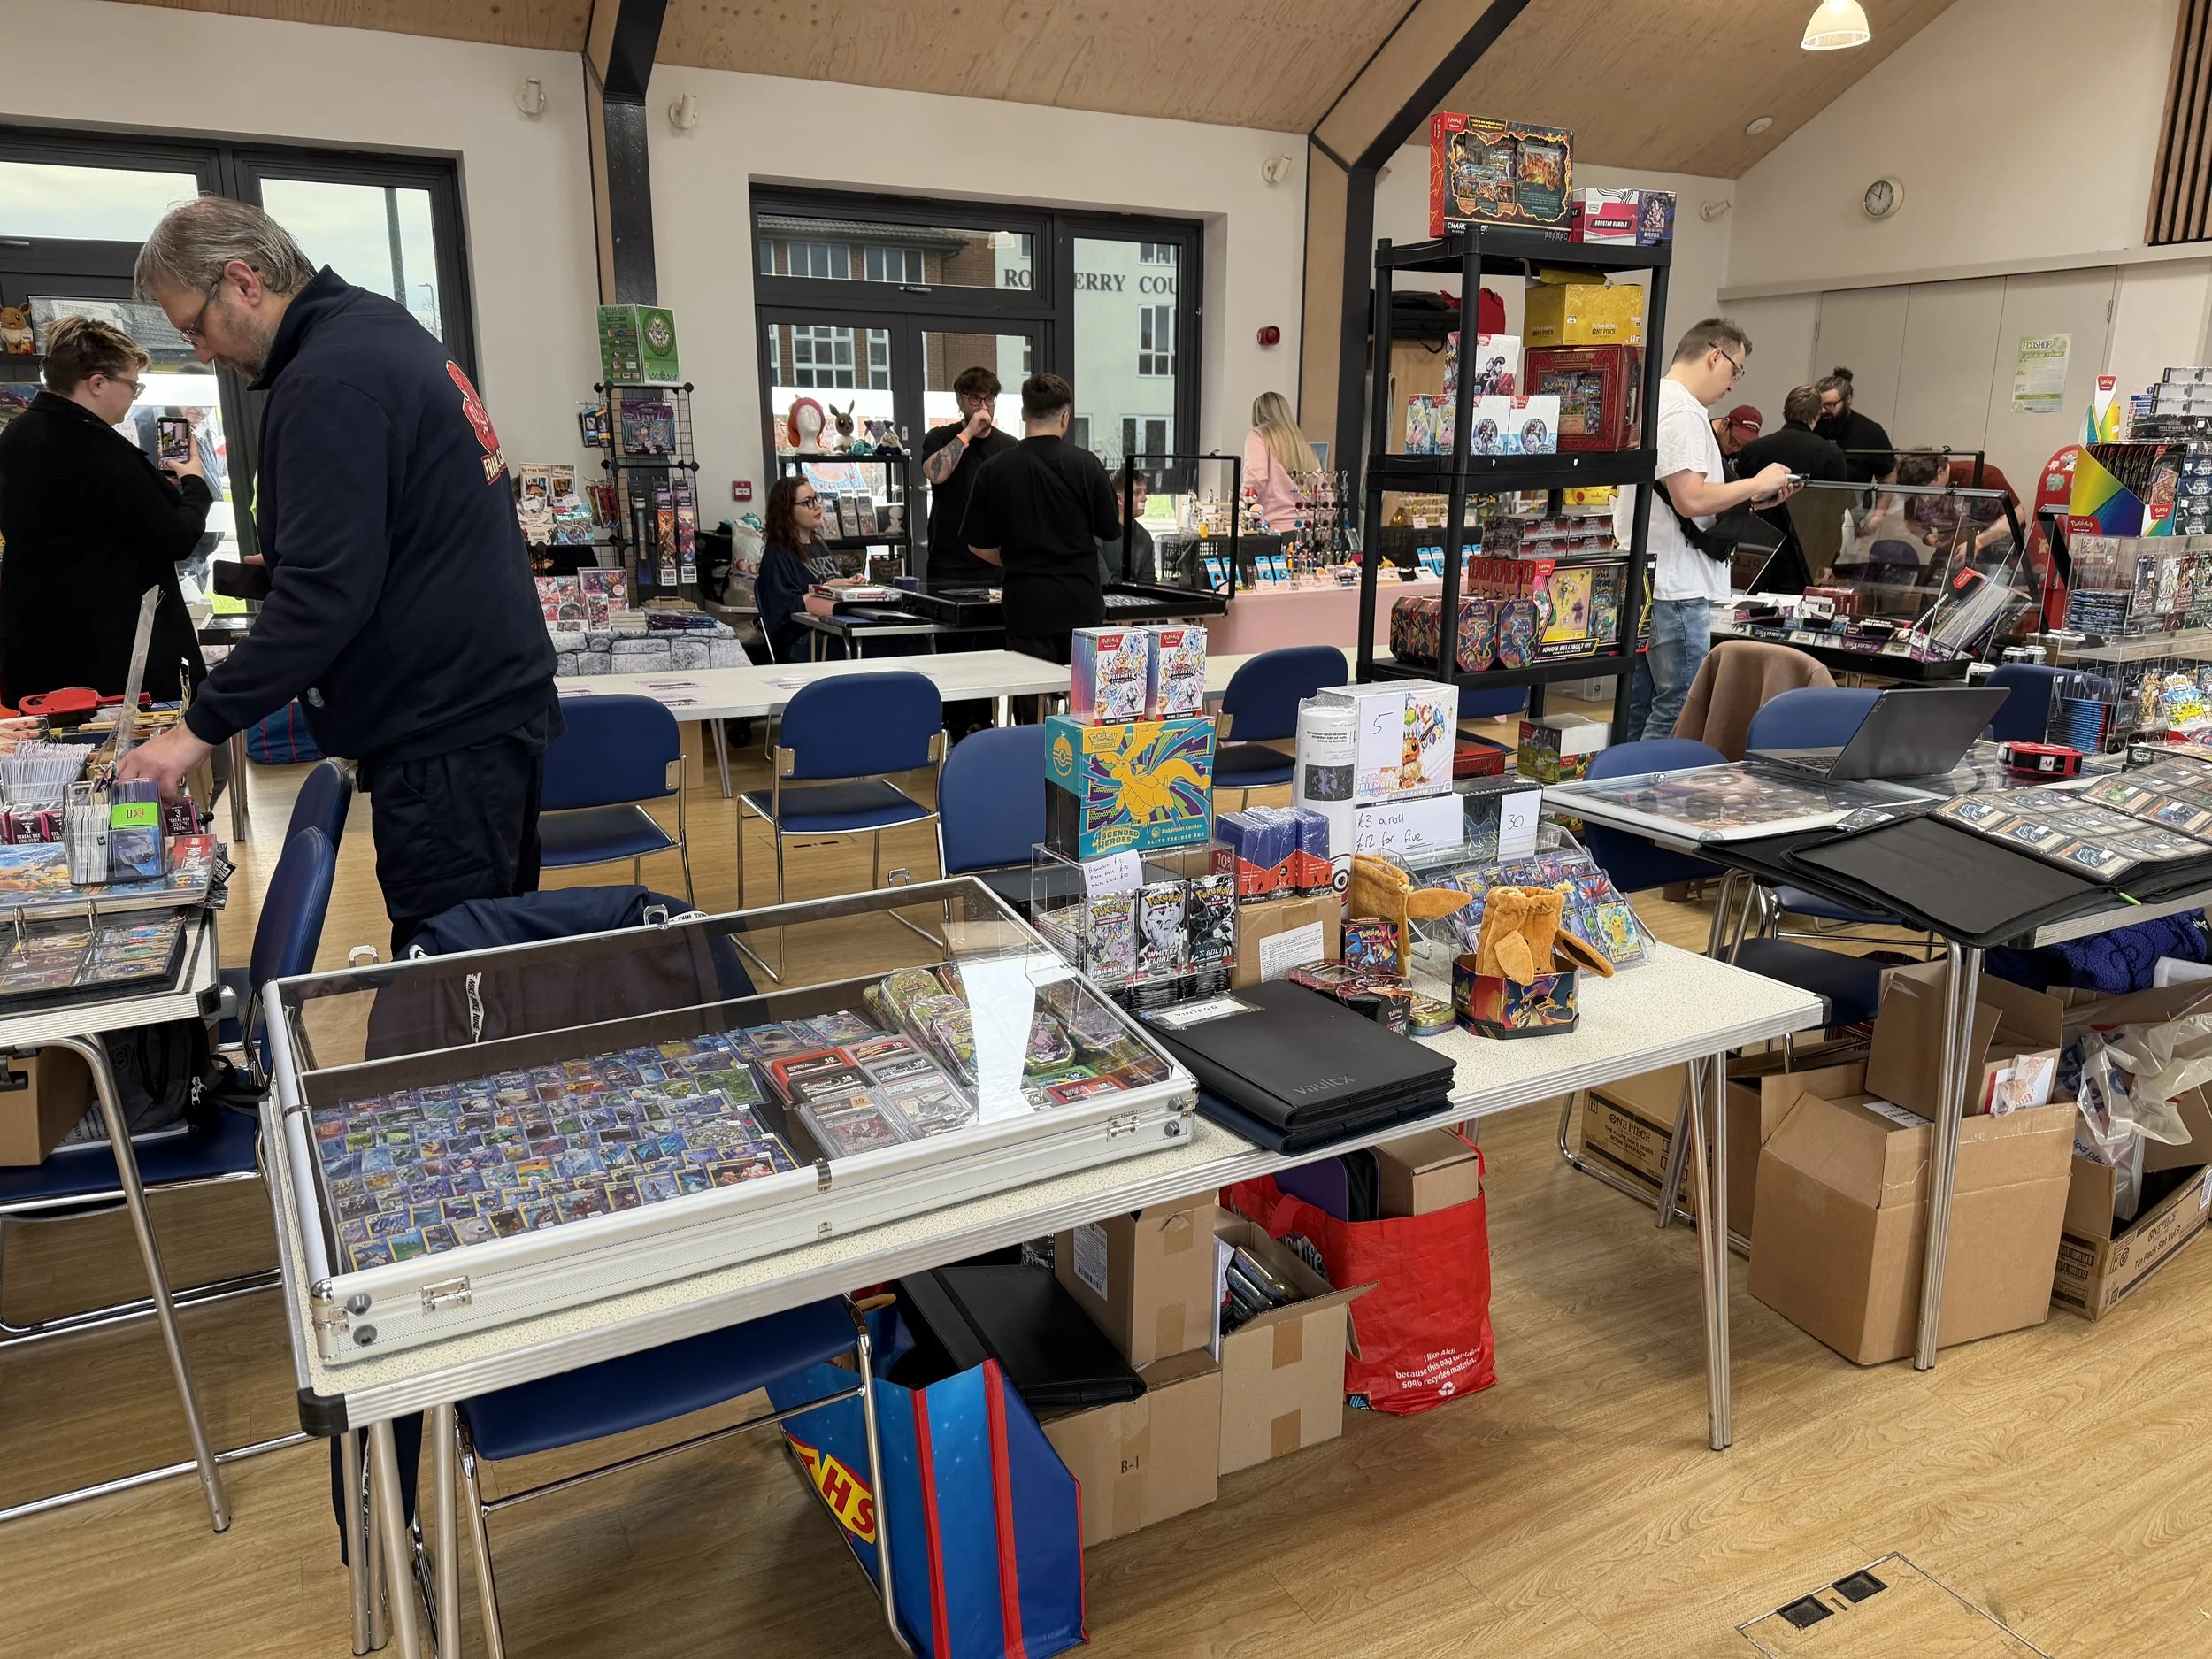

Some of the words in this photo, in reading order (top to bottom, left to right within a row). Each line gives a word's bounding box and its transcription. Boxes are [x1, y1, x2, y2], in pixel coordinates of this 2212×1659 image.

[2022, 340, 2053, 350] ECOSHOP
[1373, 712, 1393, 735] 5
[1088, 732, 1118, 743] Pokémon
[1357, 780, 1398, 791] PRISMATIC
[175, 809, 181, 818] 3
[1357, 812, 1373, 829] £3
[1388, 812, 1404, 825] roll
[24, 825, 31, 834] 3
[1508, 814, 1525, 830] 30
[1094, 829, 1139, 844] ASCENDED
[1161, 826, 1185, 834] Pokémon
[1097, 837, 1132, 851] HEROES
[1167, 834, 1193, 842] TRAINER
[1381, 832, 1394, 847] for
[1404, 829, 1423, 842] five
[1146, 892, 1183, 907] Pokémon
[1195, 885, 1231, 900] Pokémon
[1092, 903, 1131, 918] Pokémon
[1358, 929, 1386, 939] Pokémon
[1148, 948, 1177, 957] WHITE
[1092, 965, 1129, 975] PRISMATIC
[468, 978, 476, 997] NIKE
[1628, 1122, 1651, 1142] PIECE
[1610, 1134, 1632, 1151] BOOSTER
[1631, 1145, 1647, 1158] PACK
[2161, 1210, 2177, 1233] PIECE
[2134, 1259, 2143, 1269] Tin
[2143, 1246, 2157, 1262] Pack
[2157, 1237, 2167, 1252] Set
[1427, 1352, 1440, 1362] like
[1395, 1367, 1427, 1379] because
[1427, 1362, 1440, 1372] this
[1440, 1357, 1453, 1368] bag
[1402, 1379, 1422, 1390] 50%
[1423, 1369, 1450, 1386] recycled
[1121, 1455, 1140, 1475] B-1
